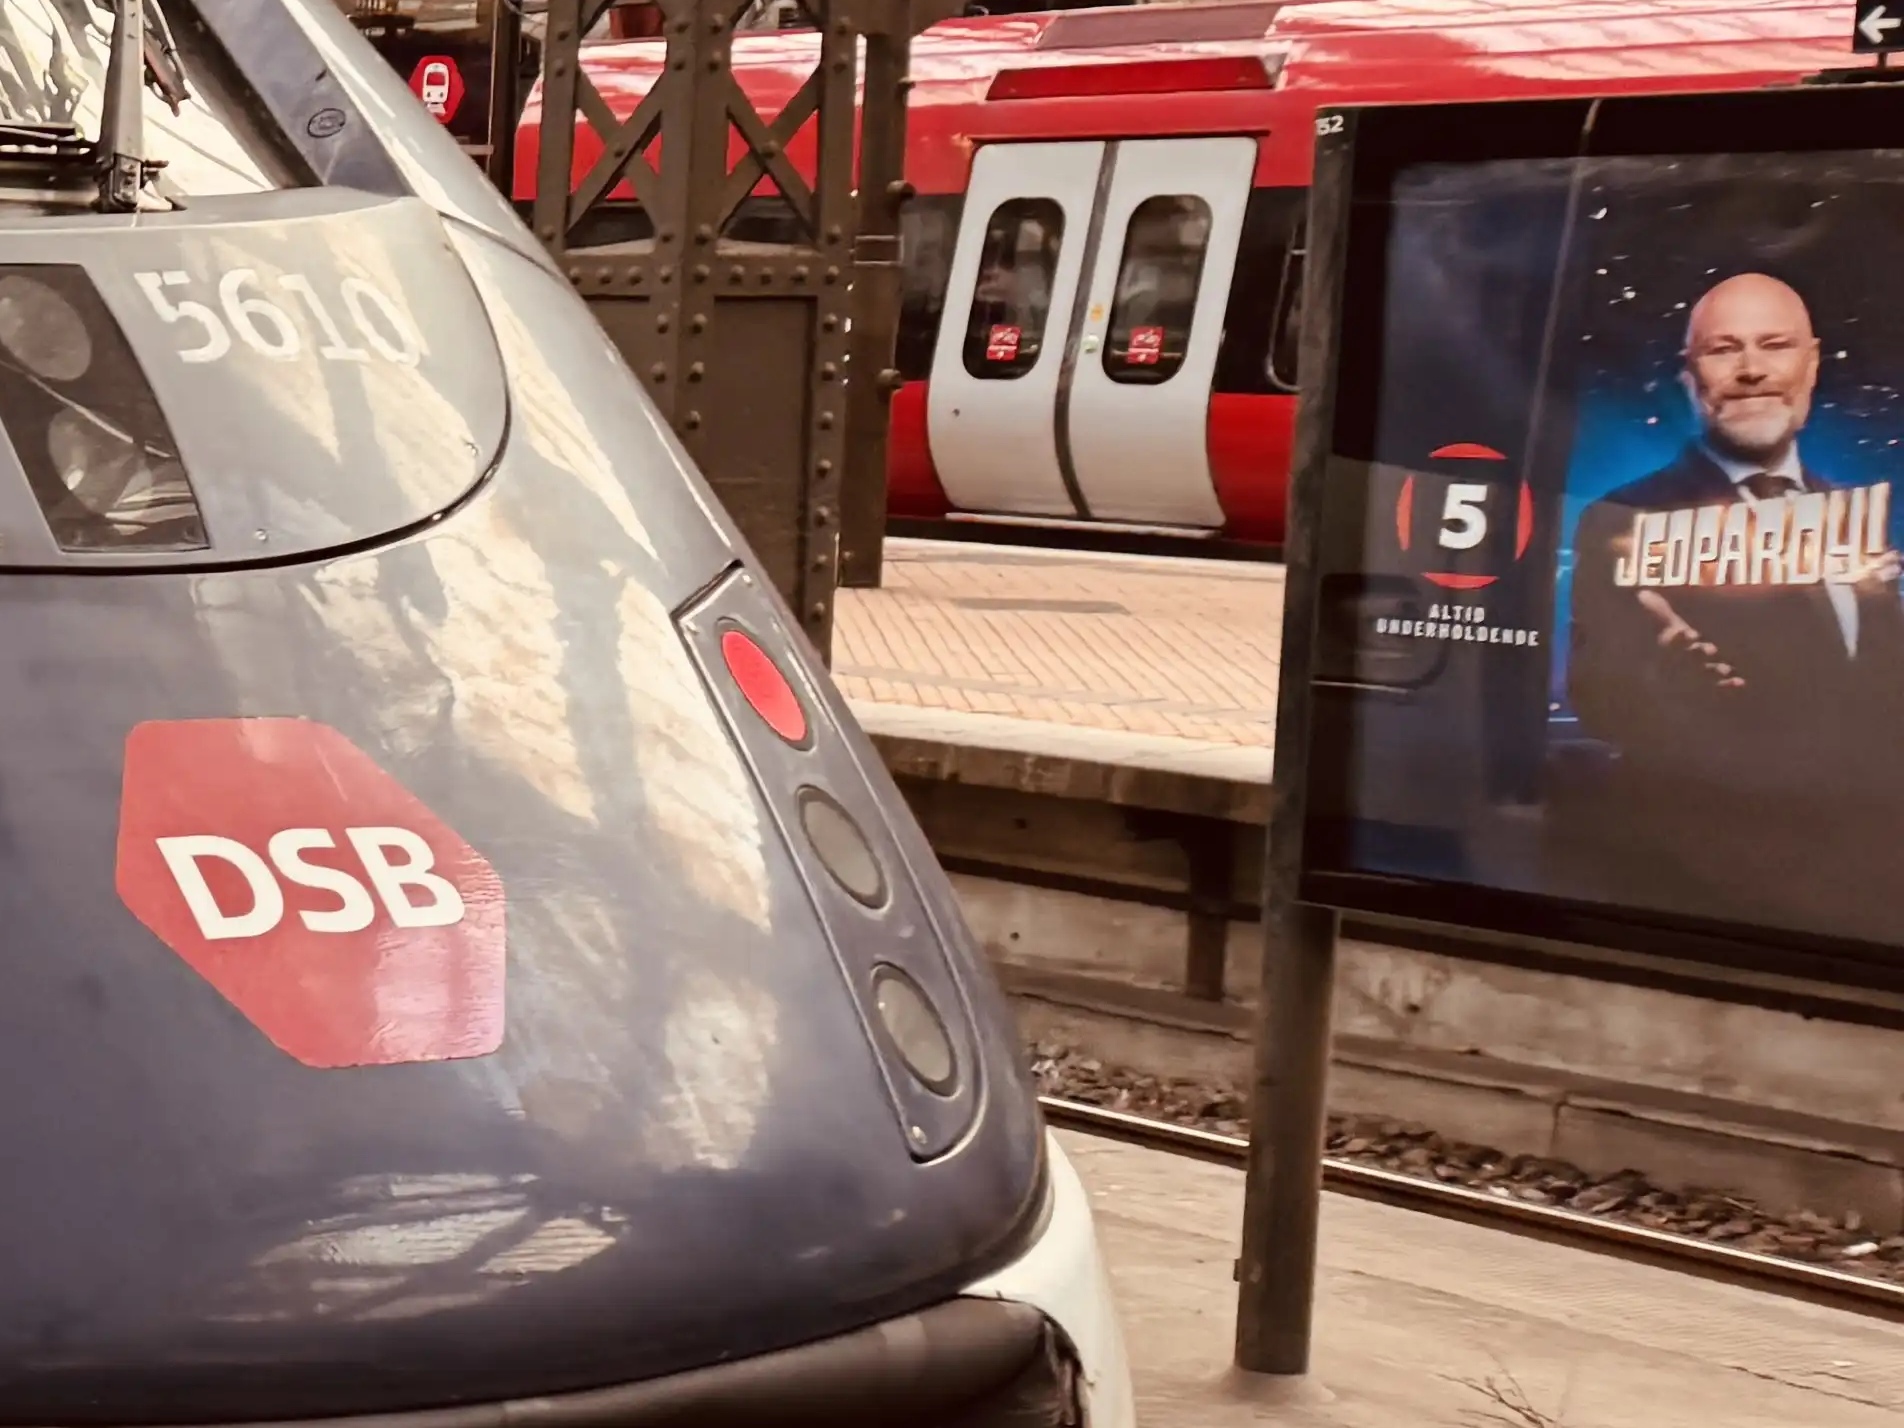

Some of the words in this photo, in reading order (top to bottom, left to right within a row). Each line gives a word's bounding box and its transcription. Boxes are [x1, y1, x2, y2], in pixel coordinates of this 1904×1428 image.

[133, 269, 431, 368] 5610
[1438, 483, 1488, 550] 5
[1613, 481, 1891, 587] JEOPARDY!
[155, 826, 465, 940] DSB
